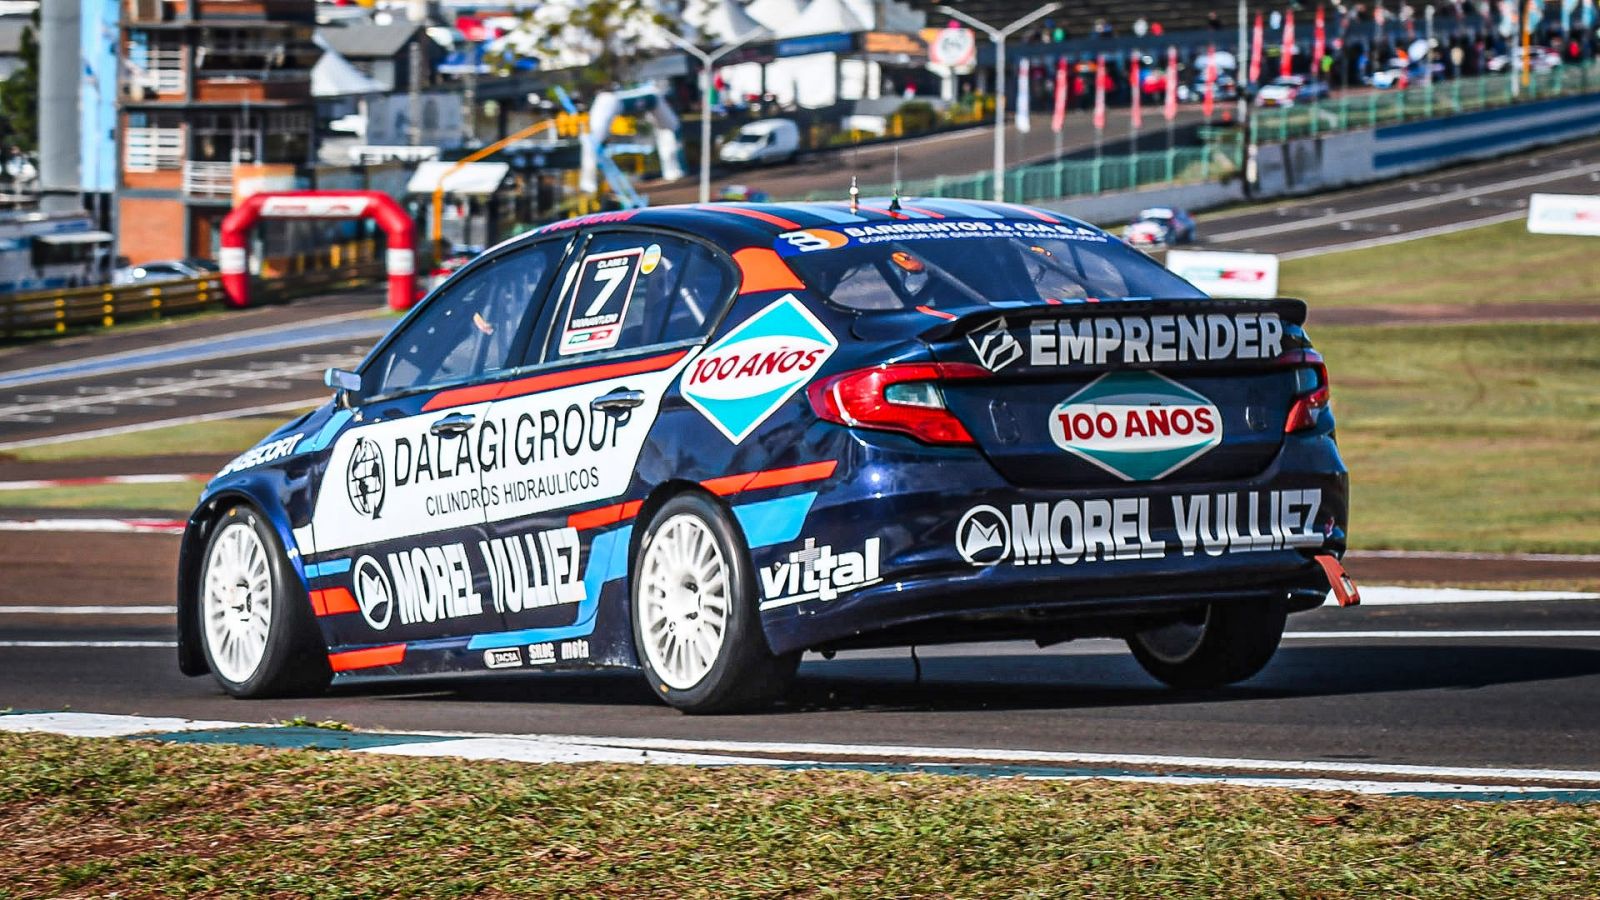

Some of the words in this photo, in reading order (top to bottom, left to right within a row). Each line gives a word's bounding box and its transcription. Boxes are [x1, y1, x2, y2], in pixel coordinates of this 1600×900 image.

[844, 222, 993, 237] BARRIENTOS
[995, 222, 1014, 232] &
[584, 265, 629, 317] 7
[1029, 313, 1283, 366] EMPRENDER
[689, 355, 740, 386] 100
[735, 346, 825, 379] AÑOS
[394, 415, 507, 487] DALAGI
[514, 401, 632, 466] GROUP
[1058, 408, 1118, 441] 100
[1124, 402, 1215, 438] AÑOS
[426, 486, 500, 517] CILINDROS
[503, 466, 600, 504] HIDRAULICOS
[1011, 497, 1166, 566] MOREL
[1171, 488, 1325, 557] VULLIEZ
[387, 542, 483, 625] MOREL
[479, 526, 587, 614] VULLIEZ
[760, 537, 881, 602] vittal
